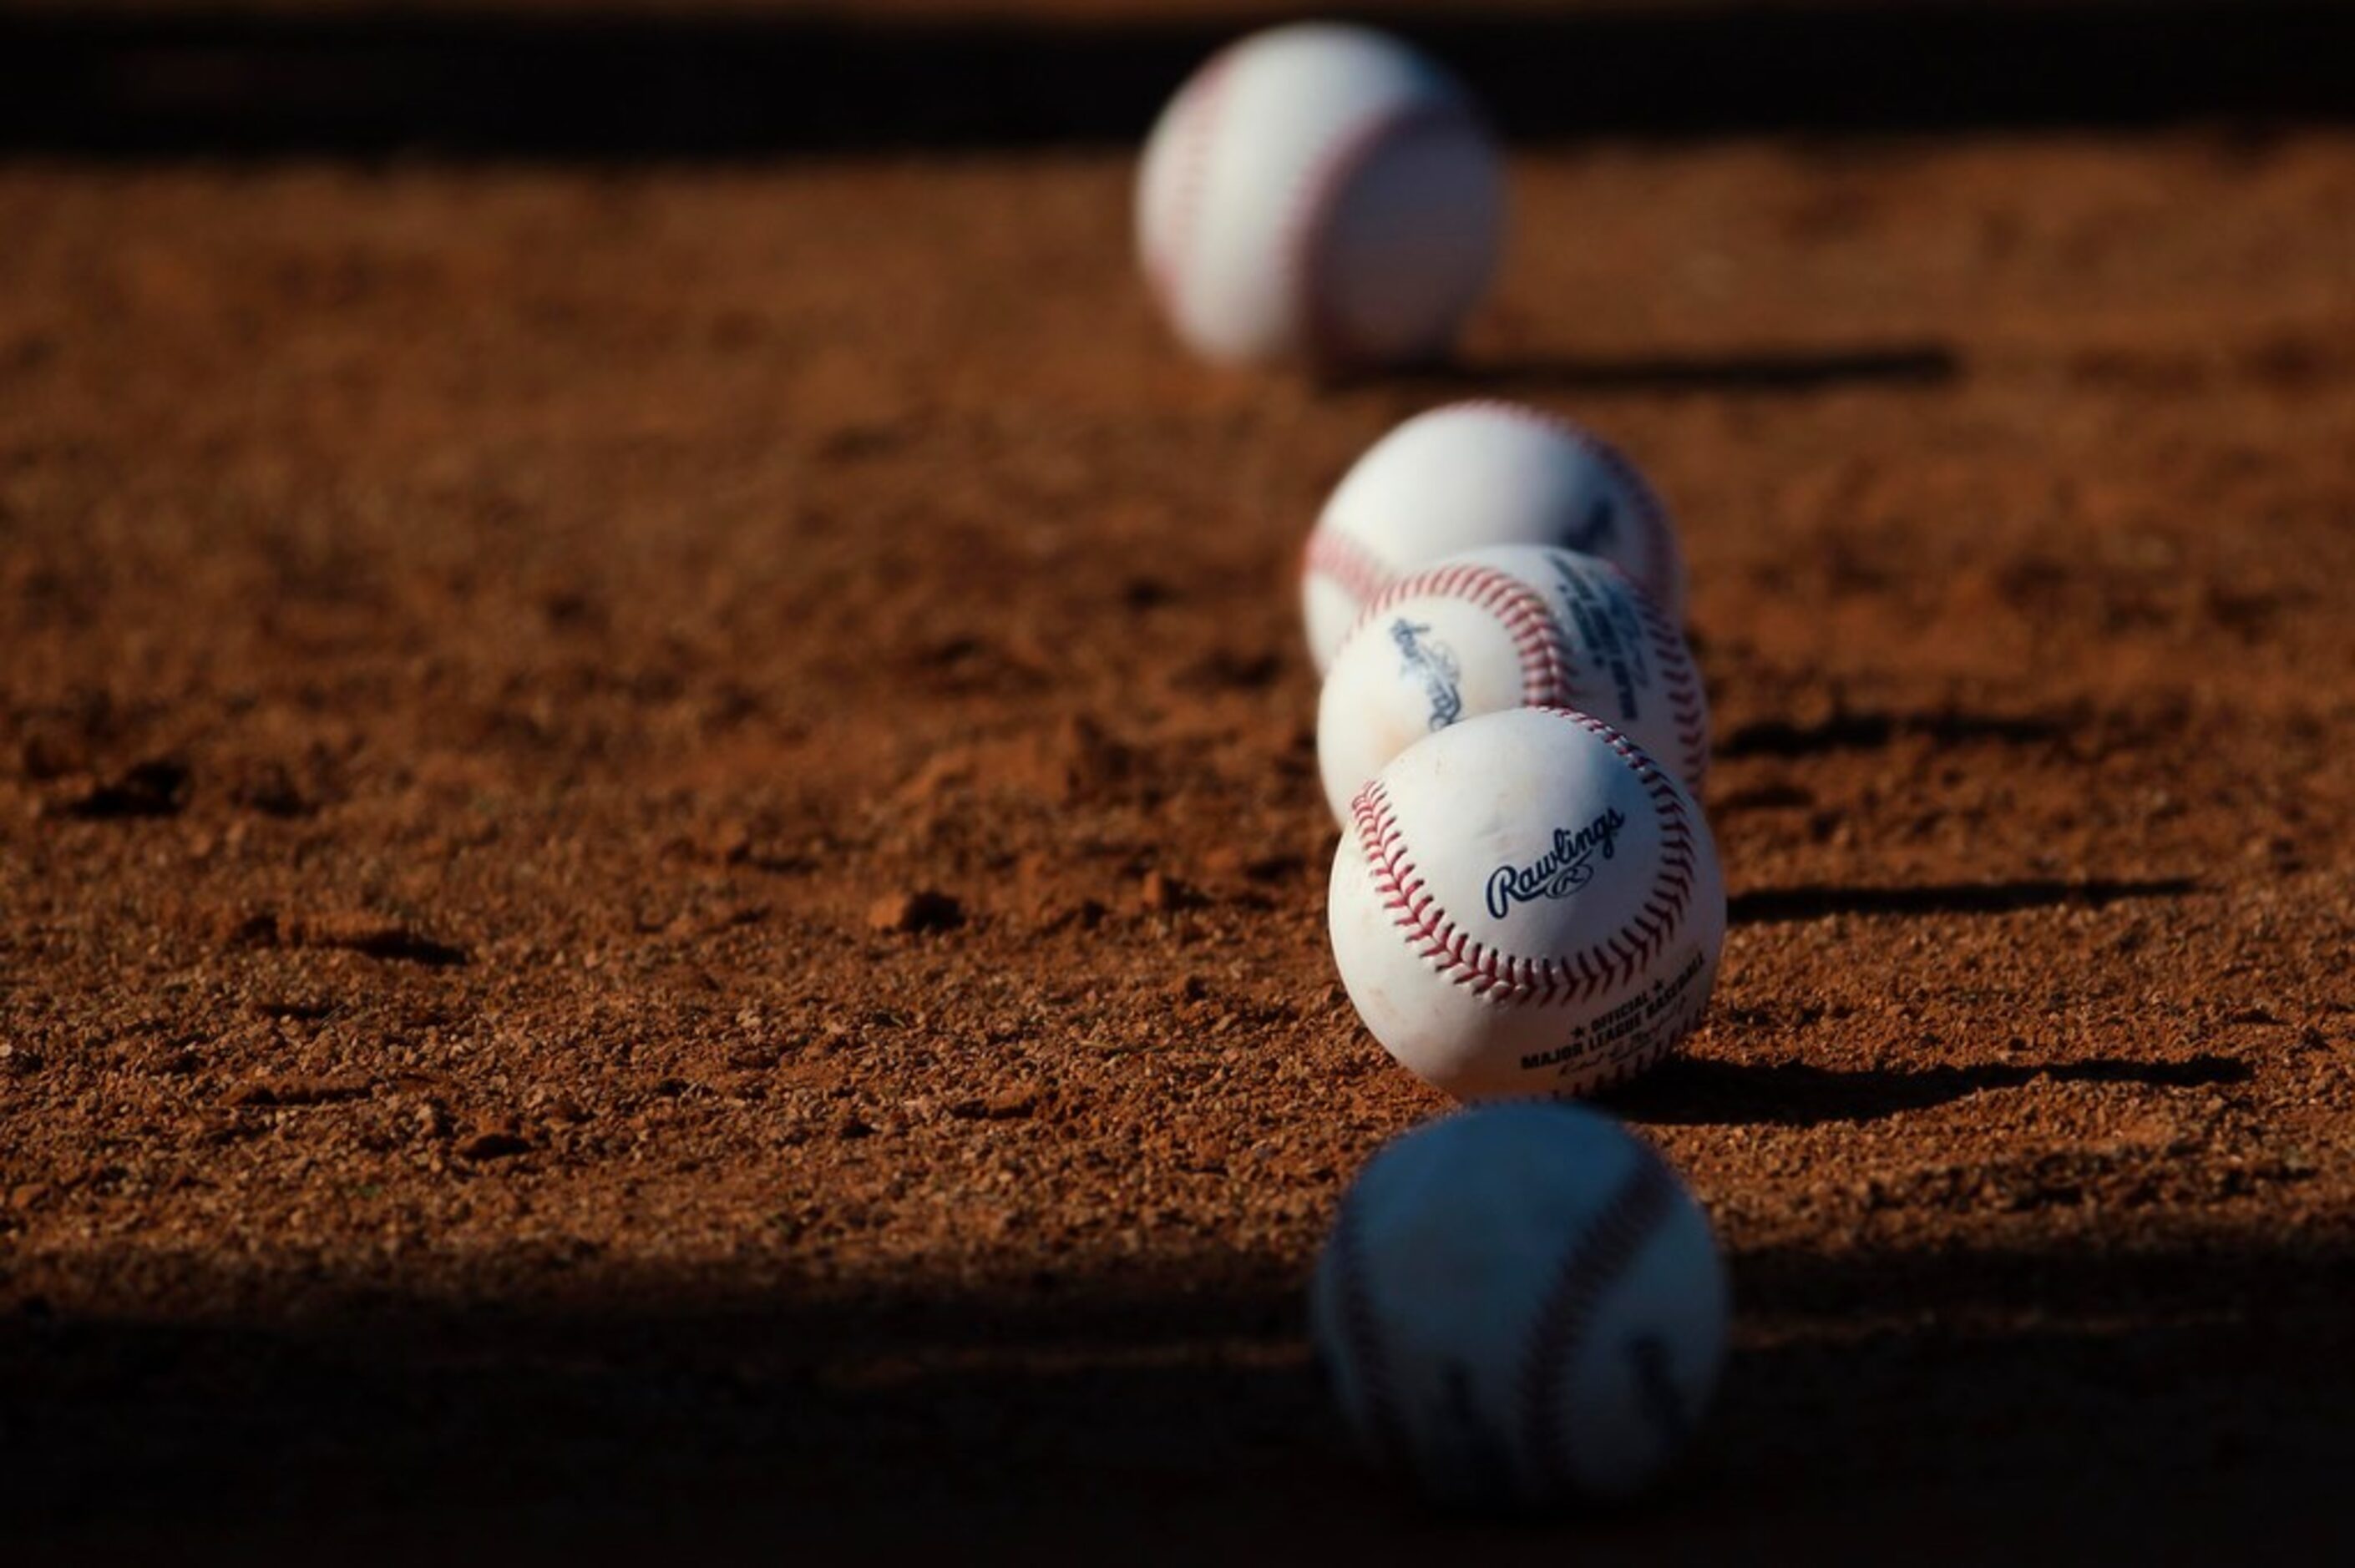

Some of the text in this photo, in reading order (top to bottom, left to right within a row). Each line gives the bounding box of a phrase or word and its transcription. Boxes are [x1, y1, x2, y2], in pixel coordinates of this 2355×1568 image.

[1486, 805, 1625, 919] Rawlings
[1592, 990, 1648, 1032] OFFICIAL
[1521, 1043, 1583, 1070] MAJOR
[1588, 1012, 1642, 1051] LEAGUE
